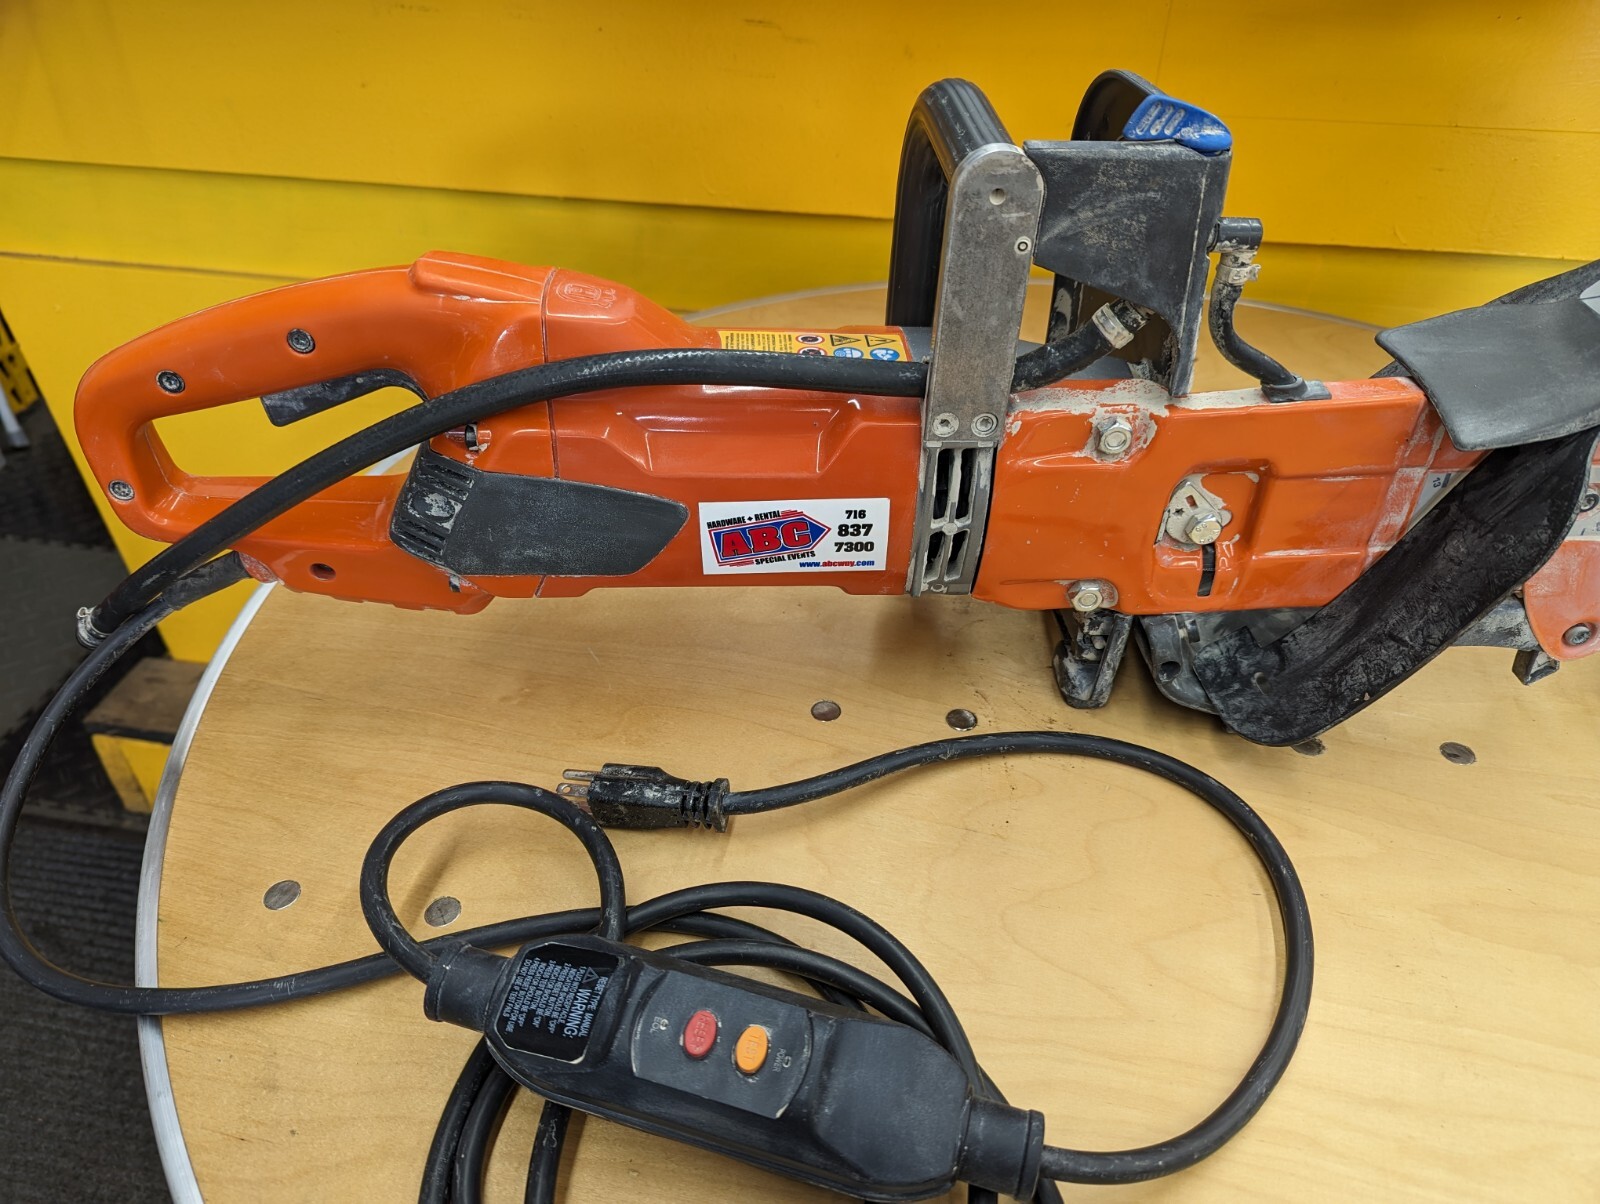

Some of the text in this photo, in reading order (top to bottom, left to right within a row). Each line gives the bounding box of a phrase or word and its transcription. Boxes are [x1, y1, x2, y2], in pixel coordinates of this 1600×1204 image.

[1432, 477, 1441, 488] 13
[707, 510, 782, 529] HARDWARE RENTAL
[845, 509, 867, 520] 716
[837, 523, 874, 537] 837
[720, 521, 812, 558] ABC
[834, 541, 875, 553] 7300
[754, 550, 816, 566] SPECIAL EVENTS
[520, 966, 528, 976] NOT
[532, 962, 546, 986] INDICATOR
[546, 965, 562, 989] INDICATOR
[515, 976, 524, 986] USE
[522, 975, 533, 990] RESET
[538, 979, 548, 990] TEST
[562, 968, 577, 992] INDICATOR
[569, 981, 579, 992] INTO
[594, 977, 608, 995] RESET
[508, 991, 518, 1003] TEST
[524, 986, 536, 1005] SHOULD
[552, 981, 563, 997] RESET
[514, 990, 526, 1010] BUTTON
[539, 989, 551, 1008] SHOULD
[554, 992, 566, 1011] SHOULD
[503, 1003, 513, 1017] FAILS
[510, 1010, 519, 1021] FOR
[563, 989, 591, 1038] WARNING:
[578, 1013, 593, 1036] MANUAL
[743, 1032, 761, 1063] TEST
[772, 1047, 786, 1073] POWER
